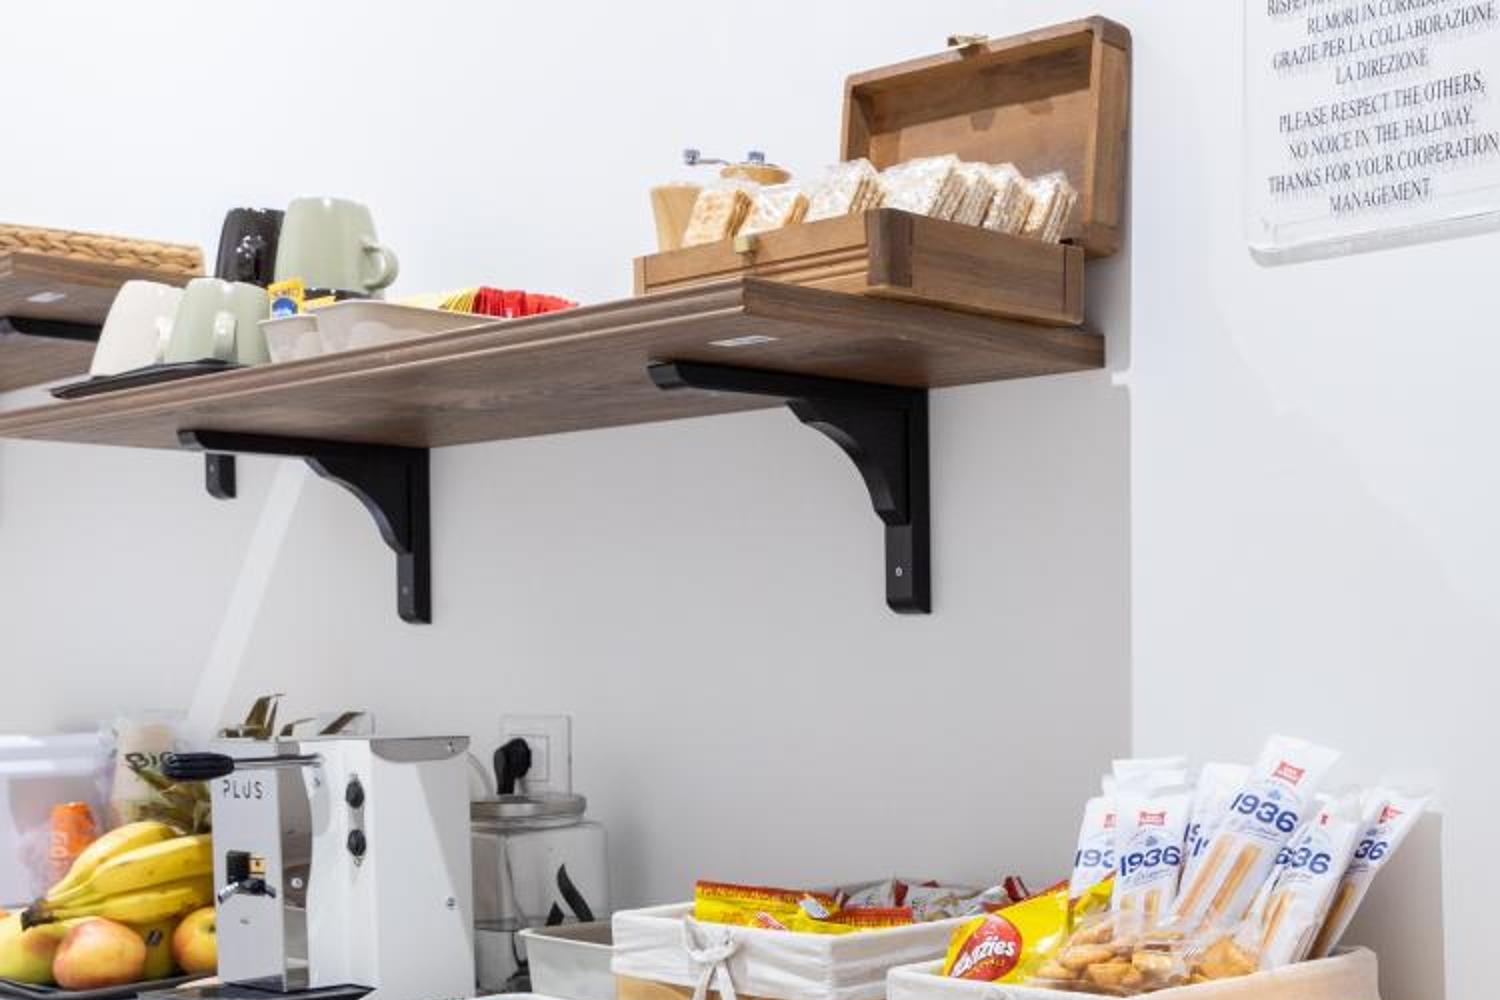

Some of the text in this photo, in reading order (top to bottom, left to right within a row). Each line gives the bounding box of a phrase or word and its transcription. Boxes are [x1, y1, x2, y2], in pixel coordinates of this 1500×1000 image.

[1307, 8, 1358, 35] RUMORI
[1361, 4, 1377, 22] IN
[1273, 40, 1318, 69] GRAZIE
[1321, 35, 1346, 60] PER
[1349, 31, 1366, 52] LA
[1336, 62, 1354, 85] LA
[1279, 107, 1328, 134] PLEASE
[1331, 92, 1389, 123] RESPECT
[1394, 85, 1421, 109] THE
[1288, 138, 1308, 161] NO
[1311, 130, 1352, 155] NOICE
[1354, 127, 1371, 149] IN
[1375, 119, 1402, 146] THE
[1267, 165, 1322, 194] THANKS
[1324, 159, 1352, 184] FOR
[1355, 152, 1395, 179] YOUR
[1329, 176, 1432, 213] MANAGEMENT
[222, 779, 264, 799] PLUS
[1230, 792, 1299, 833] 1936
[1074, 848, 1115, 869] 193
[1120, 845, 1182, 877] 1936
